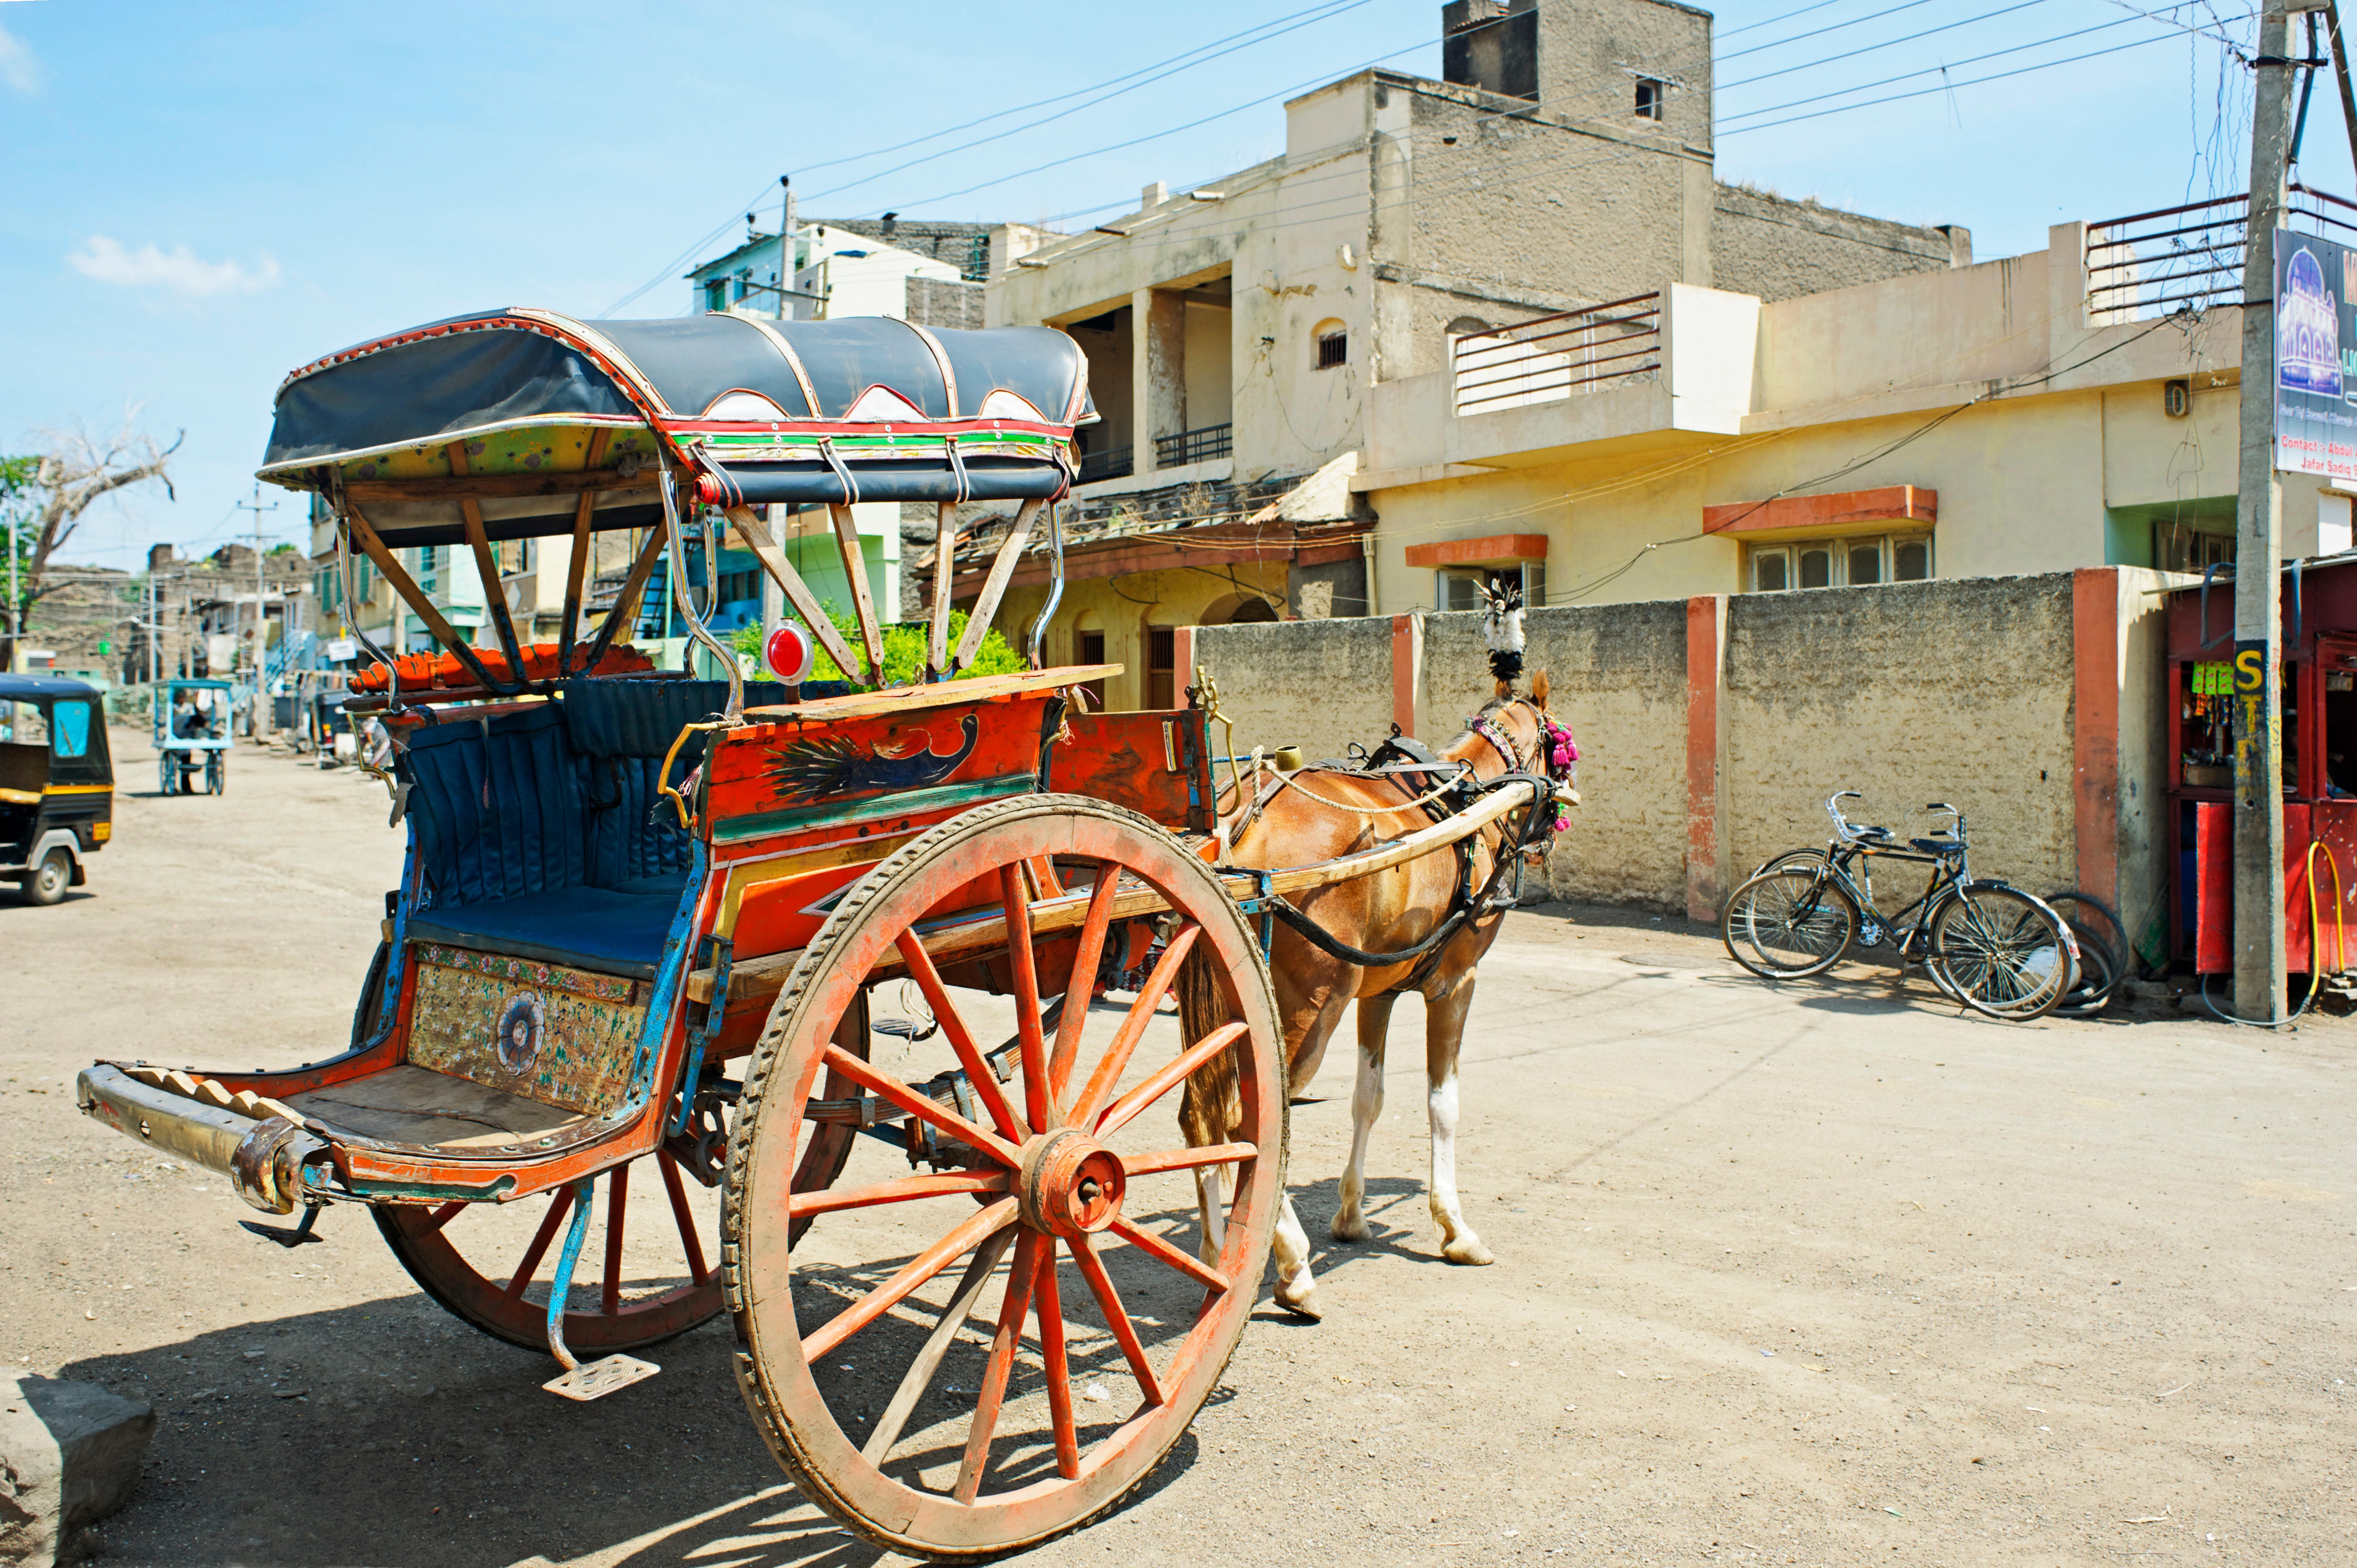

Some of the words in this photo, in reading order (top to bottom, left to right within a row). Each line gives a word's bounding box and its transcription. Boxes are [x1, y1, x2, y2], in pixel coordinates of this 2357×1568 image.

[2282, 435, 2317, 452] Contact
[2328, 442, 2352, 456] Abdul
[2301, 457, 2324, 470] Jafar
[2327, 460, 2351, 478] Sadiq
